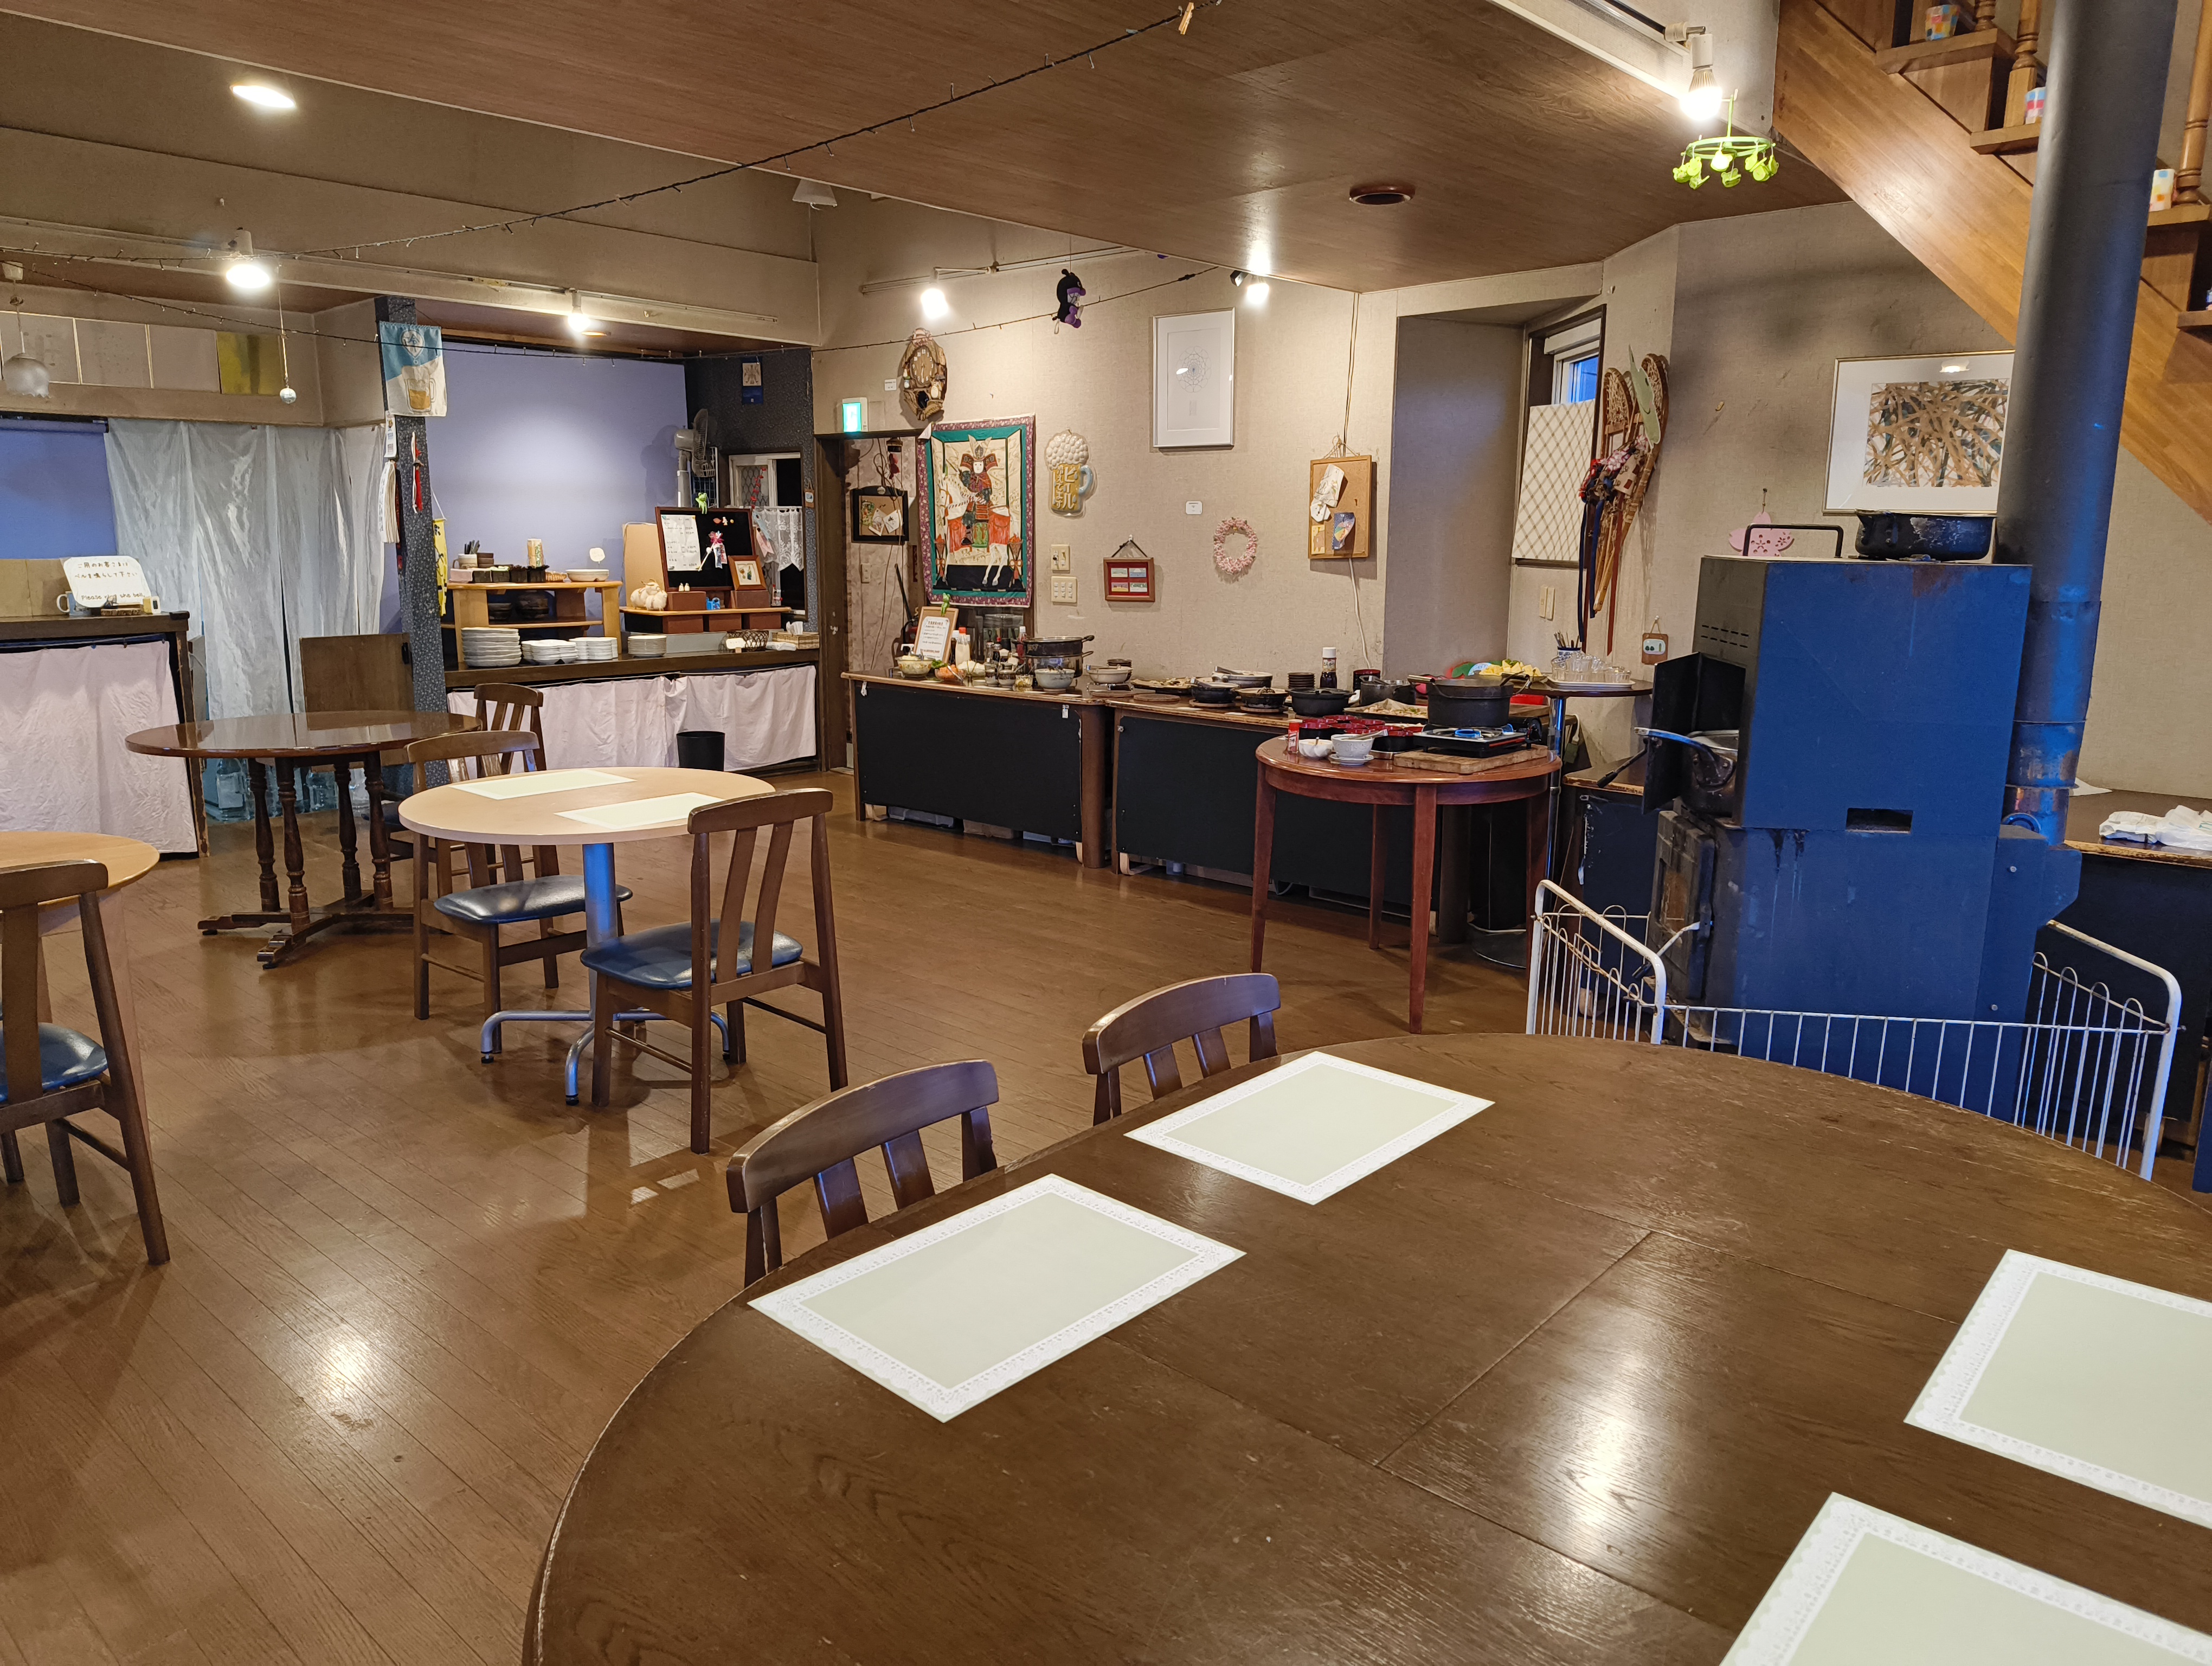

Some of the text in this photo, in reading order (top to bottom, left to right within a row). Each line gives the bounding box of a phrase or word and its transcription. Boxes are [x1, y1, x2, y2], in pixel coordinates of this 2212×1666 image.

[1056, 465, 1064, 509] 冷えてます
[1062, 466, 1076, 509] ビール
